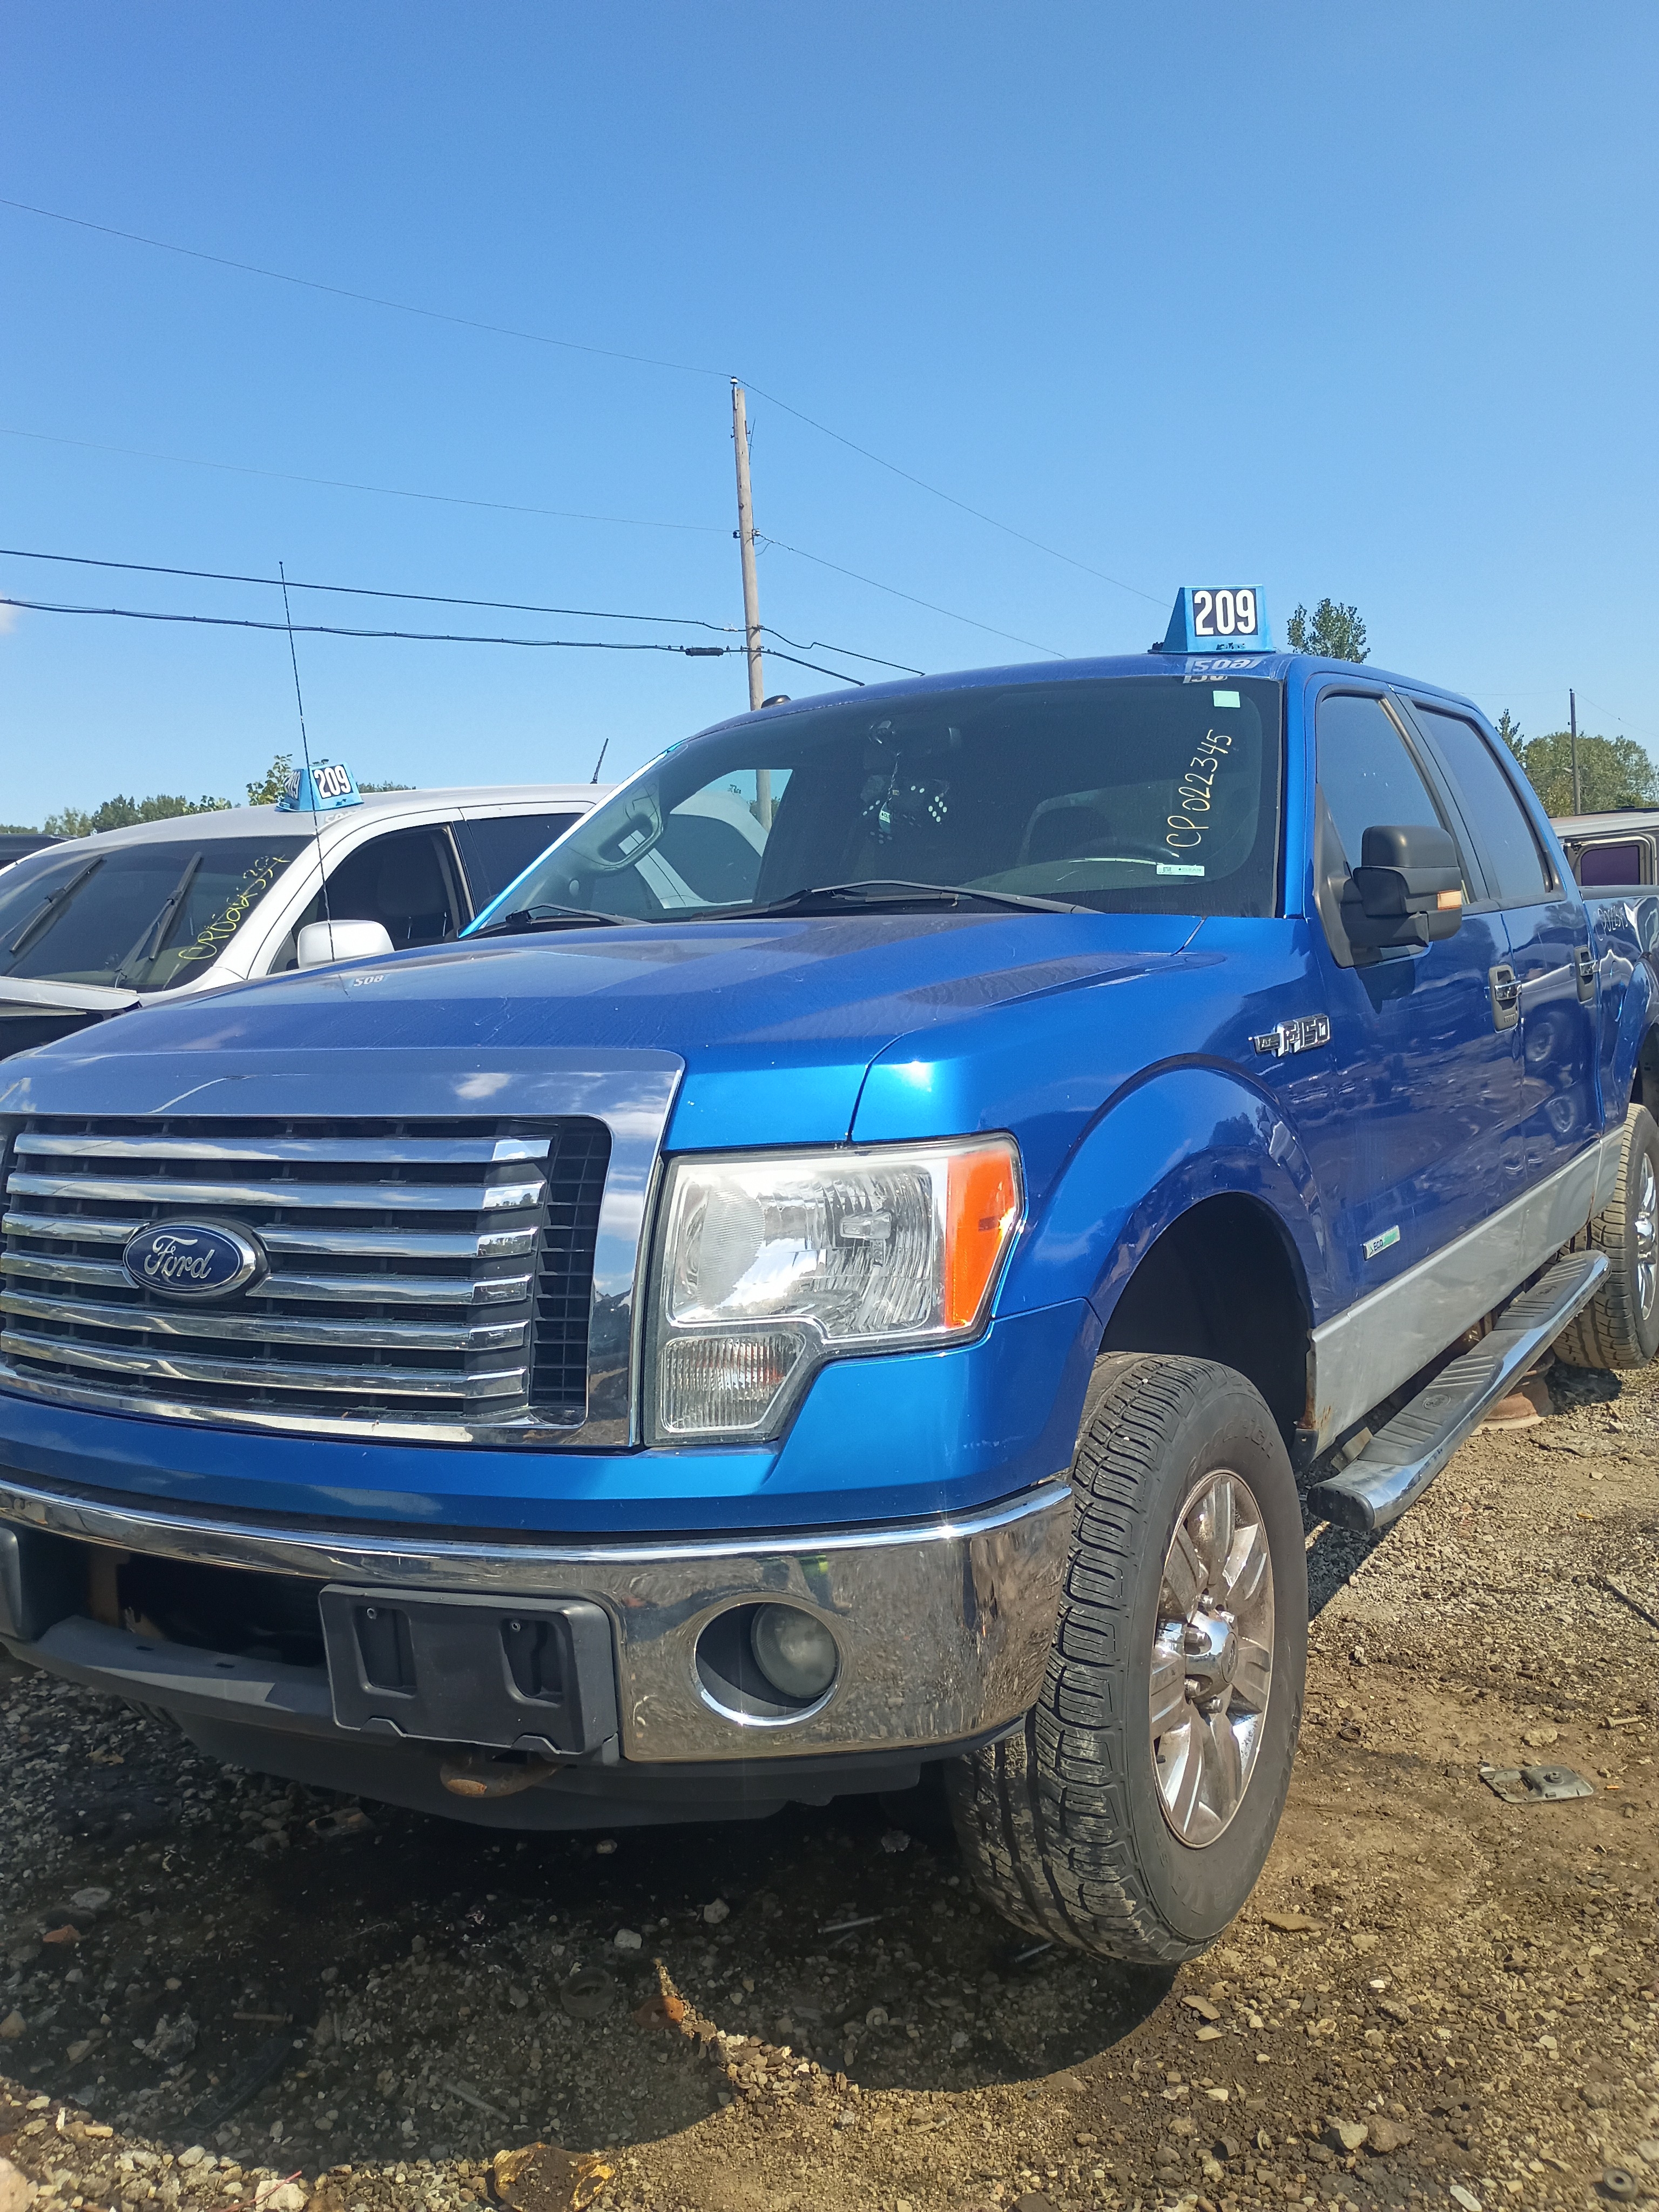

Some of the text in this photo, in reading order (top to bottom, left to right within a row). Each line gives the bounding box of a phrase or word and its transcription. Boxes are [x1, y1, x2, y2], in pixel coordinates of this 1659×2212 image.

[1194, 589, 1256, 635] 209
[314, 765, 351, 798] 209
[144, 1235, 215, 1279] Ford
